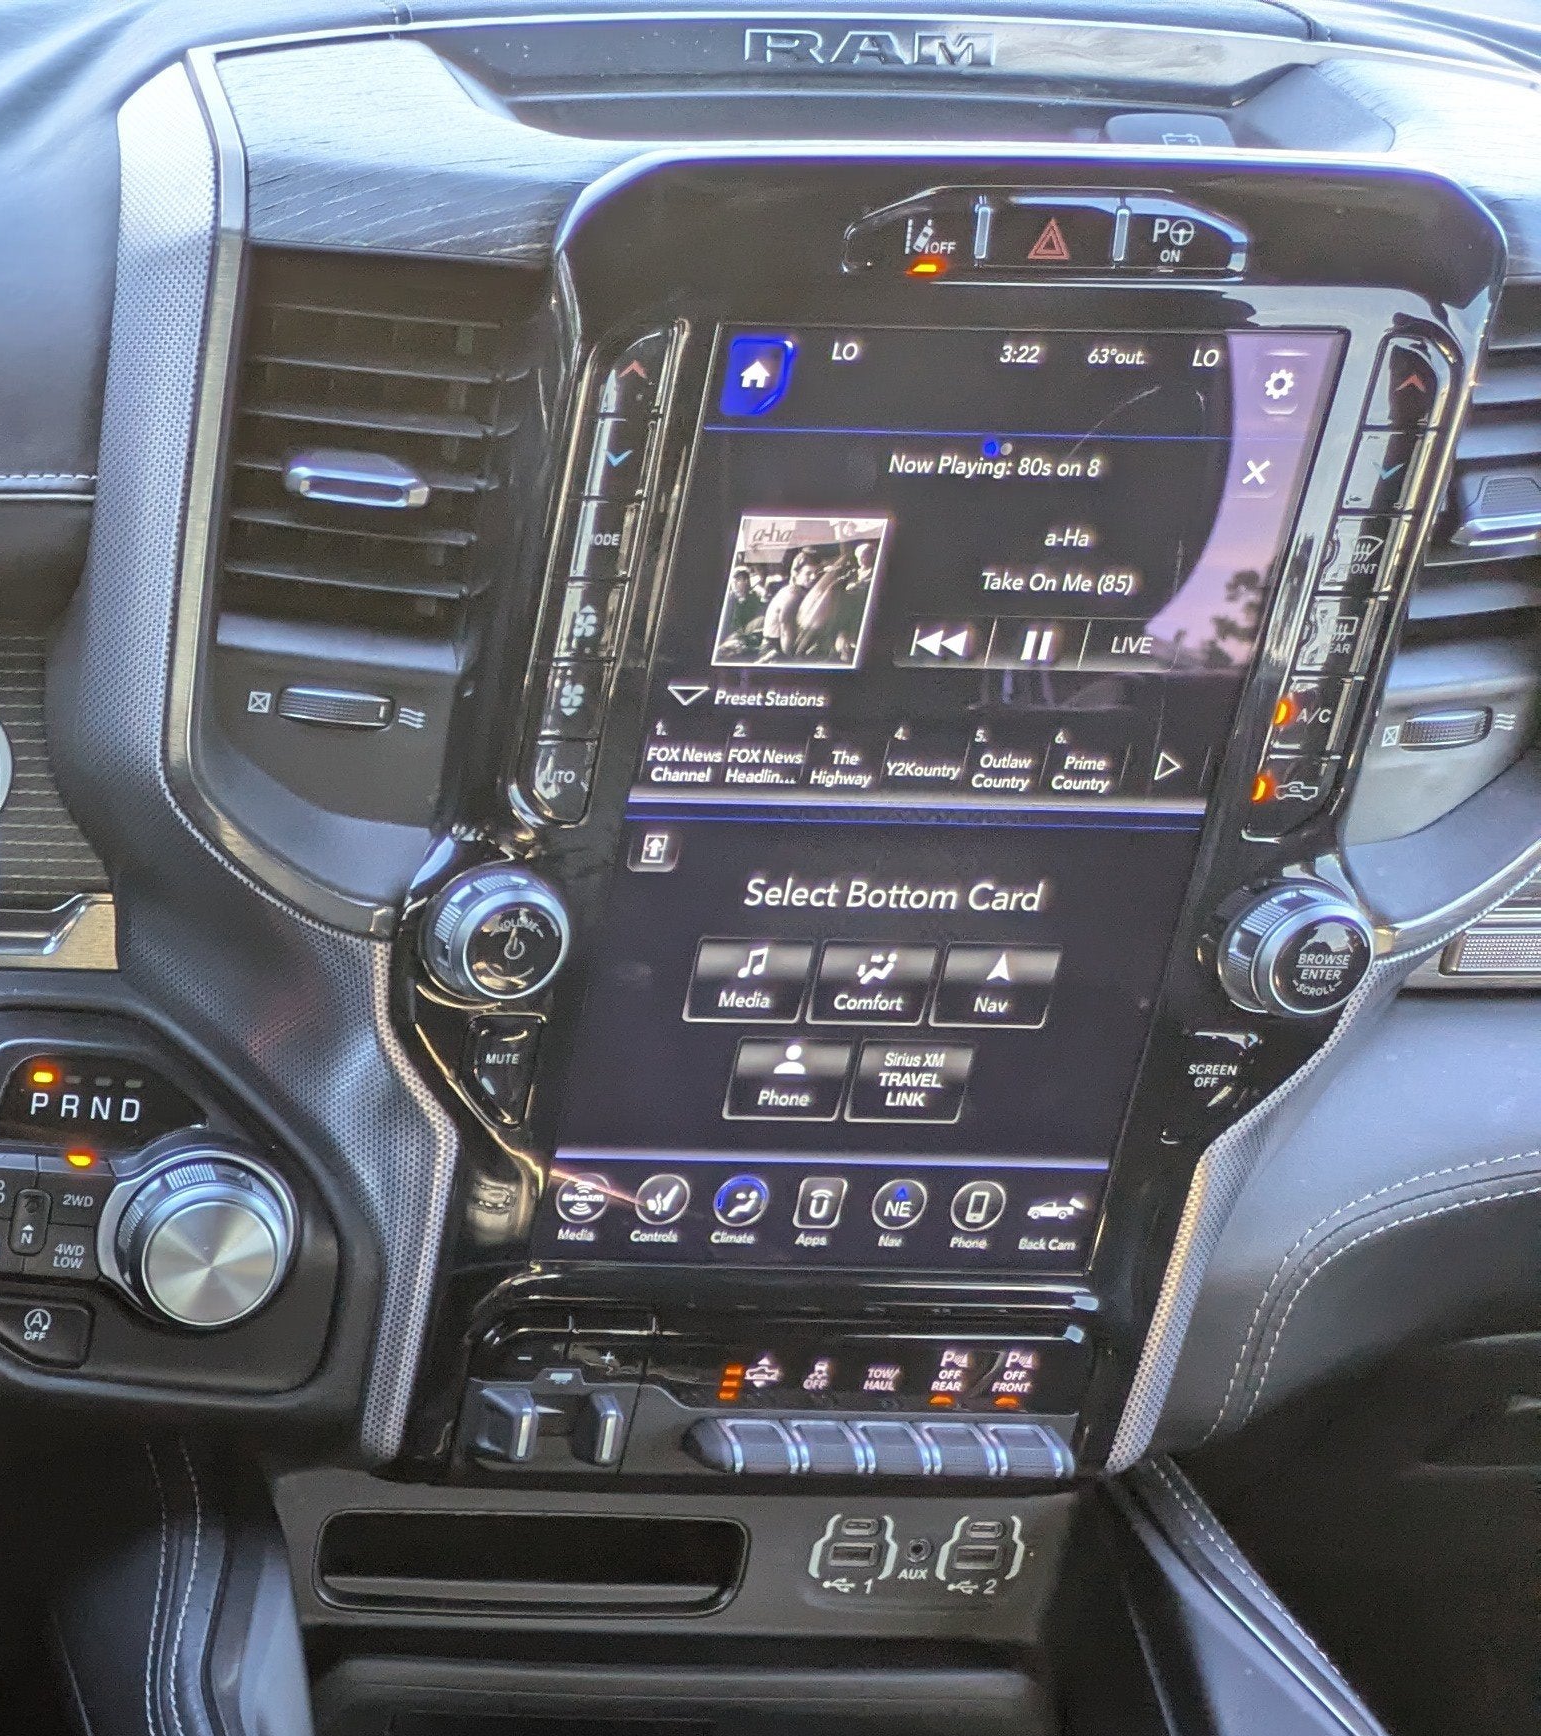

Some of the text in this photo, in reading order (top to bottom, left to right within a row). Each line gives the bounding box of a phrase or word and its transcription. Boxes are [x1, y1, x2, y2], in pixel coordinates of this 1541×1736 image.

[743, 29, 997, 66] RAM
[930, 242, 956, 254] OFF
[1160, 250, 1180, 262] ON
[832, 343, 859, 361] LO
[1000, 345, 1041, 365] 3:22
[1192, 349, 1219, 367] LO
[889, 456, 1101, 481] Now Playing: 80s on 8
[1044, 530, 1089, 548] a-Ha
[982, 572, 1133, 596] Take On Me (85)
[1111, 636, 1154, 654] LIVE
[714, 692, 825, 707] Preset Stations
[1296, 708, 1332, 723] A/C
[647, 747, 722, 762] FOX News
[728, 749, 803, 764] FOX News
[831, 751, 859, 766] The
[980, 752, 1031, 769] Outlaw
[887, 762, 961, 780] Y2Kountry
[1064, 757, 1106, 771] Prime
[651, 767, 711, 782] Channel
[810, 770, 872, 788] Highway
[971, 774, 1030, 791] Country
[1051, 776, 1109, 793] Country
[743, 879, 1045, 911] Select Bottom Card
[1297, 953, 1350, 965] BROWSE
[1300, 968, 1341, 980] ENTER
[718, 991, 771, 1009] Media
[833, 994, 904, 1012] Comfort
[973, 997, 1009, 1014] Nav
[485, 1053, 520, 1065] MUTE
[884, 1052, 945, 1068] Sirius XM
[1188, 1064, 1238, 1076] SCREEN
[878, 1072, 942, 1088] TRAVEL
[1194, 1077, 1218, 1088] OFF
[758, 1090, 811, 1107] Phone
[885, 1092, 925, 1107] LINK
[30, 1092, 141, 1123] P R N D
[63, 1194, 94, 1207] 2WD
[884, 1201, 912, 1218] NE
[21, 1232, 33, 1244] N
[558, 1228, 594, 1241] Media
[630, 1230, 678, 1242] Controls
[710, 1231, 755, 1244] Climate
[795, 1233, 828, 1247] Apps
[878, 1236, 903, 1247] Nav
[54, 1243, 85, 1256] 4WD
[950, 1237, 988, 1249] Phone
[1018, 1238, 1076, 1252] Back Cam
[53, 1256, 83, 1269] LOW
[23, 1331, 46, 1341] OFF
[939, 1370, 963, 1380] OFF
[1003, 1370, 1026, 1381] OFF
[803, 1379, 829, 1390] OFF
[863, 1380, 895, 1391] HAUL
[931, 1381, 962, 1391] REAR
[991, 1382, 1033, 1392] FRONT
[897, 1569, 928, 1581] AUX
[864, 1578, 874, 1594] 1
[983, 1579, 998, 1594] 2
